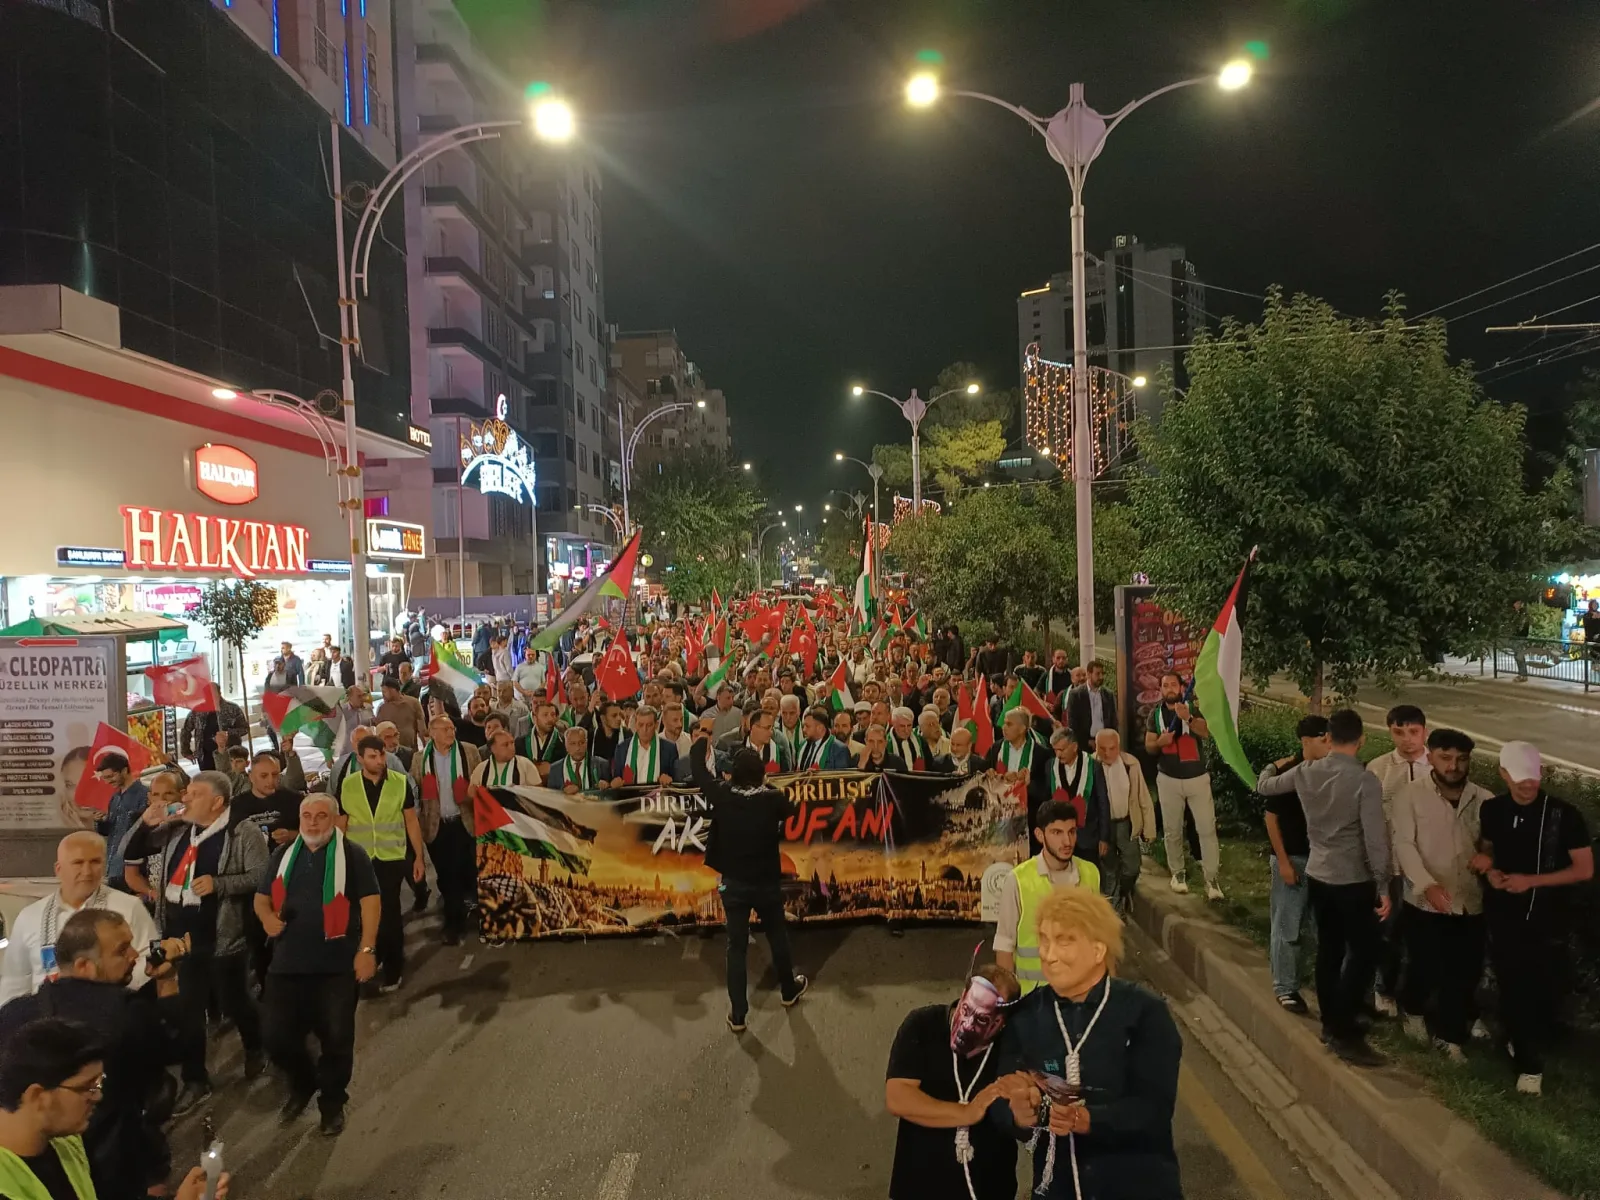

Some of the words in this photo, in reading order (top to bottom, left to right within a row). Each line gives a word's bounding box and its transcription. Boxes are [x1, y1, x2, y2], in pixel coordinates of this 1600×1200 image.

[125, 507, 306, 577] HALKTAN
[10, 656, 107, 677] CLEOPATRA
[54, 680, 107, 690] MERKEZİ
[640, 792, 714, 813] DİREN
[784, 801, 894, 846] UFANI
